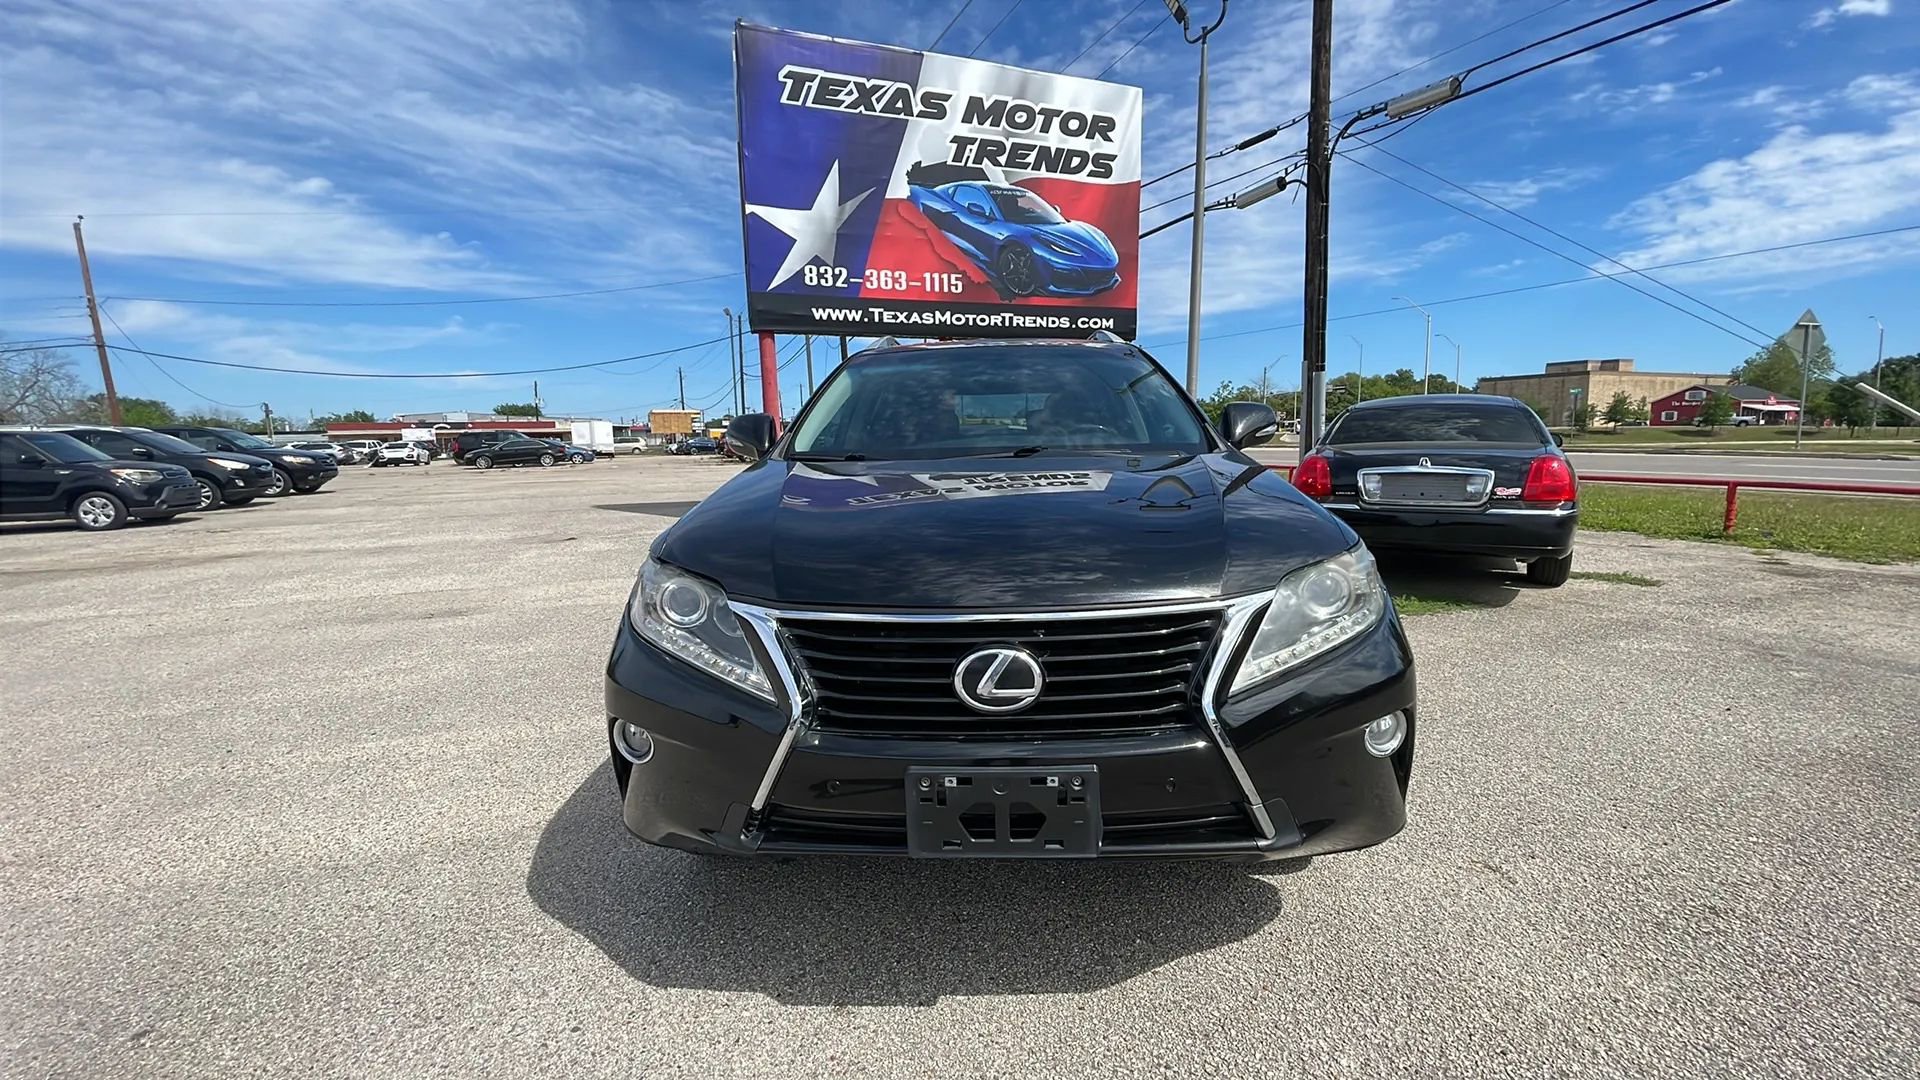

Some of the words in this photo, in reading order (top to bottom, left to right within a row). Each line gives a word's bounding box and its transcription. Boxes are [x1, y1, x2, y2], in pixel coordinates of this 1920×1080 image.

[780, 67, 954, 121] TEXAS
[961, 96, 1116, 143] MOTOR
[949, 135, 1118, 179] TRENDS
[803, 265, 964, 294] 832-363-1115
